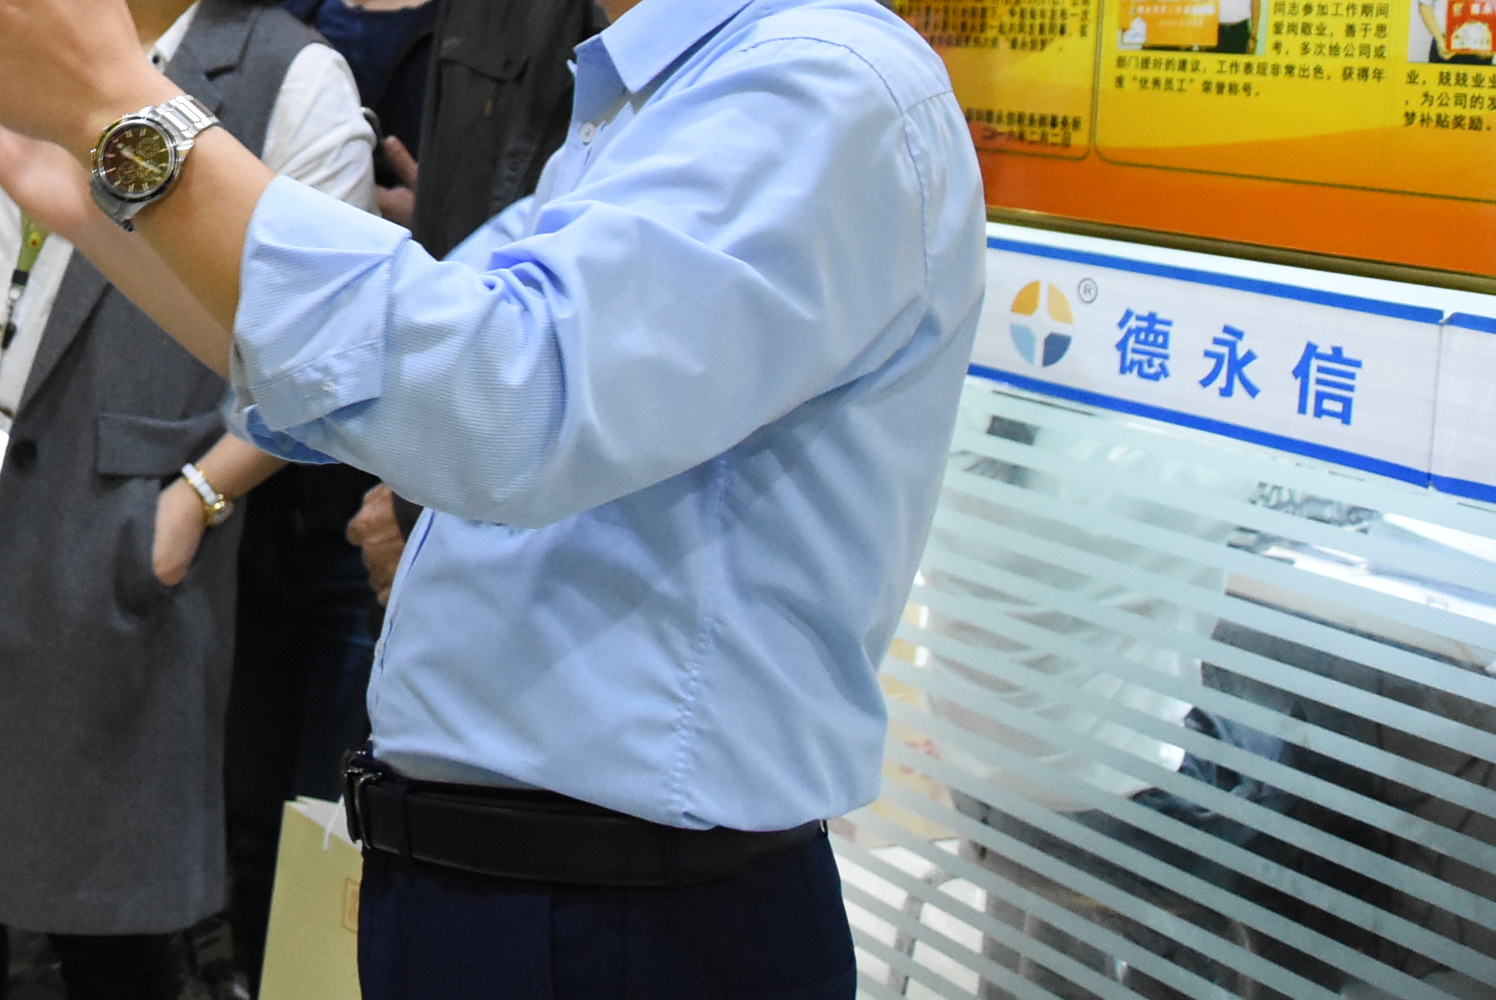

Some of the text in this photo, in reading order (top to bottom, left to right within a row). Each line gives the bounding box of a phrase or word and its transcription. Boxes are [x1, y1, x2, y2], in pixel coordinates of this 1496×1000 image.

[1273, 1, 1390, 18] 同志参加工作期间
[1114, 307, 1364, 426] 德永信
